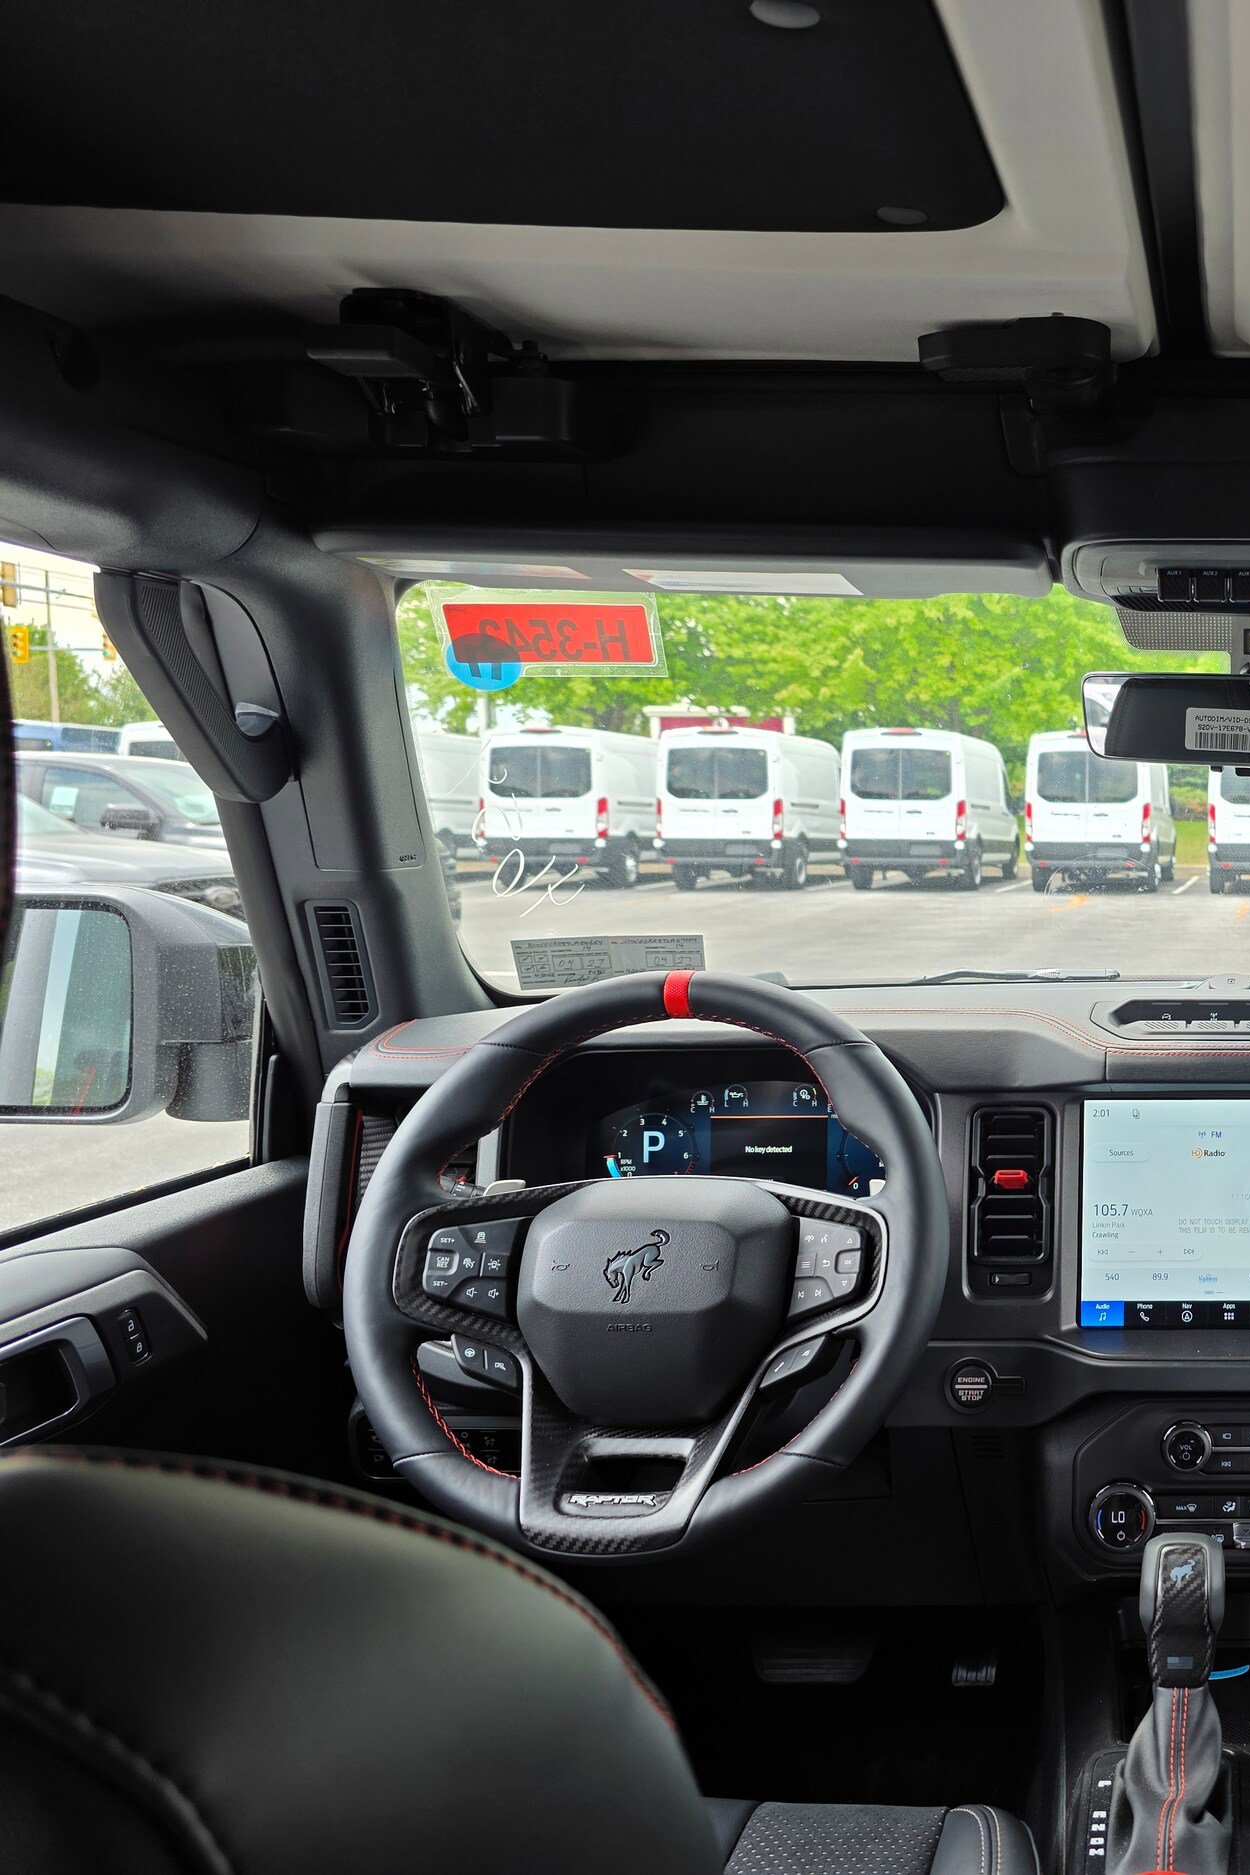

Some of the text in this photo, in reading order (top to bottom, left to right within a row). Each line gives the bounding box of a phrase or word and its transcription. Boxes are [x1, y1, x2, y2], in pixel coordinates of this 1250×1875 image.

[1093, 1109, 1110, 1117] 2:01
[643, 1131, 665, 1163] P
[754, 1146, 766, 1154] key
[766, 1145, 793, 1153] detected
[1109, 1149, 1134, 1157] Sources
[1093, 1204, 1153, 1216] 105.7 WQXA
[1092, 1221, 1126, 1229] Linkin Park
[1092, 1231, 1119, 1239] Crawling
[1105, 1273, 1119, 1281] 540
[1152, 1273, 1168, 1281] 89.9
[1223, 1303, 1236, 1311] Apps
[606, 1323, 652, 1332] AIRBAG
[1111, 1511, 1125, 1523] LO
